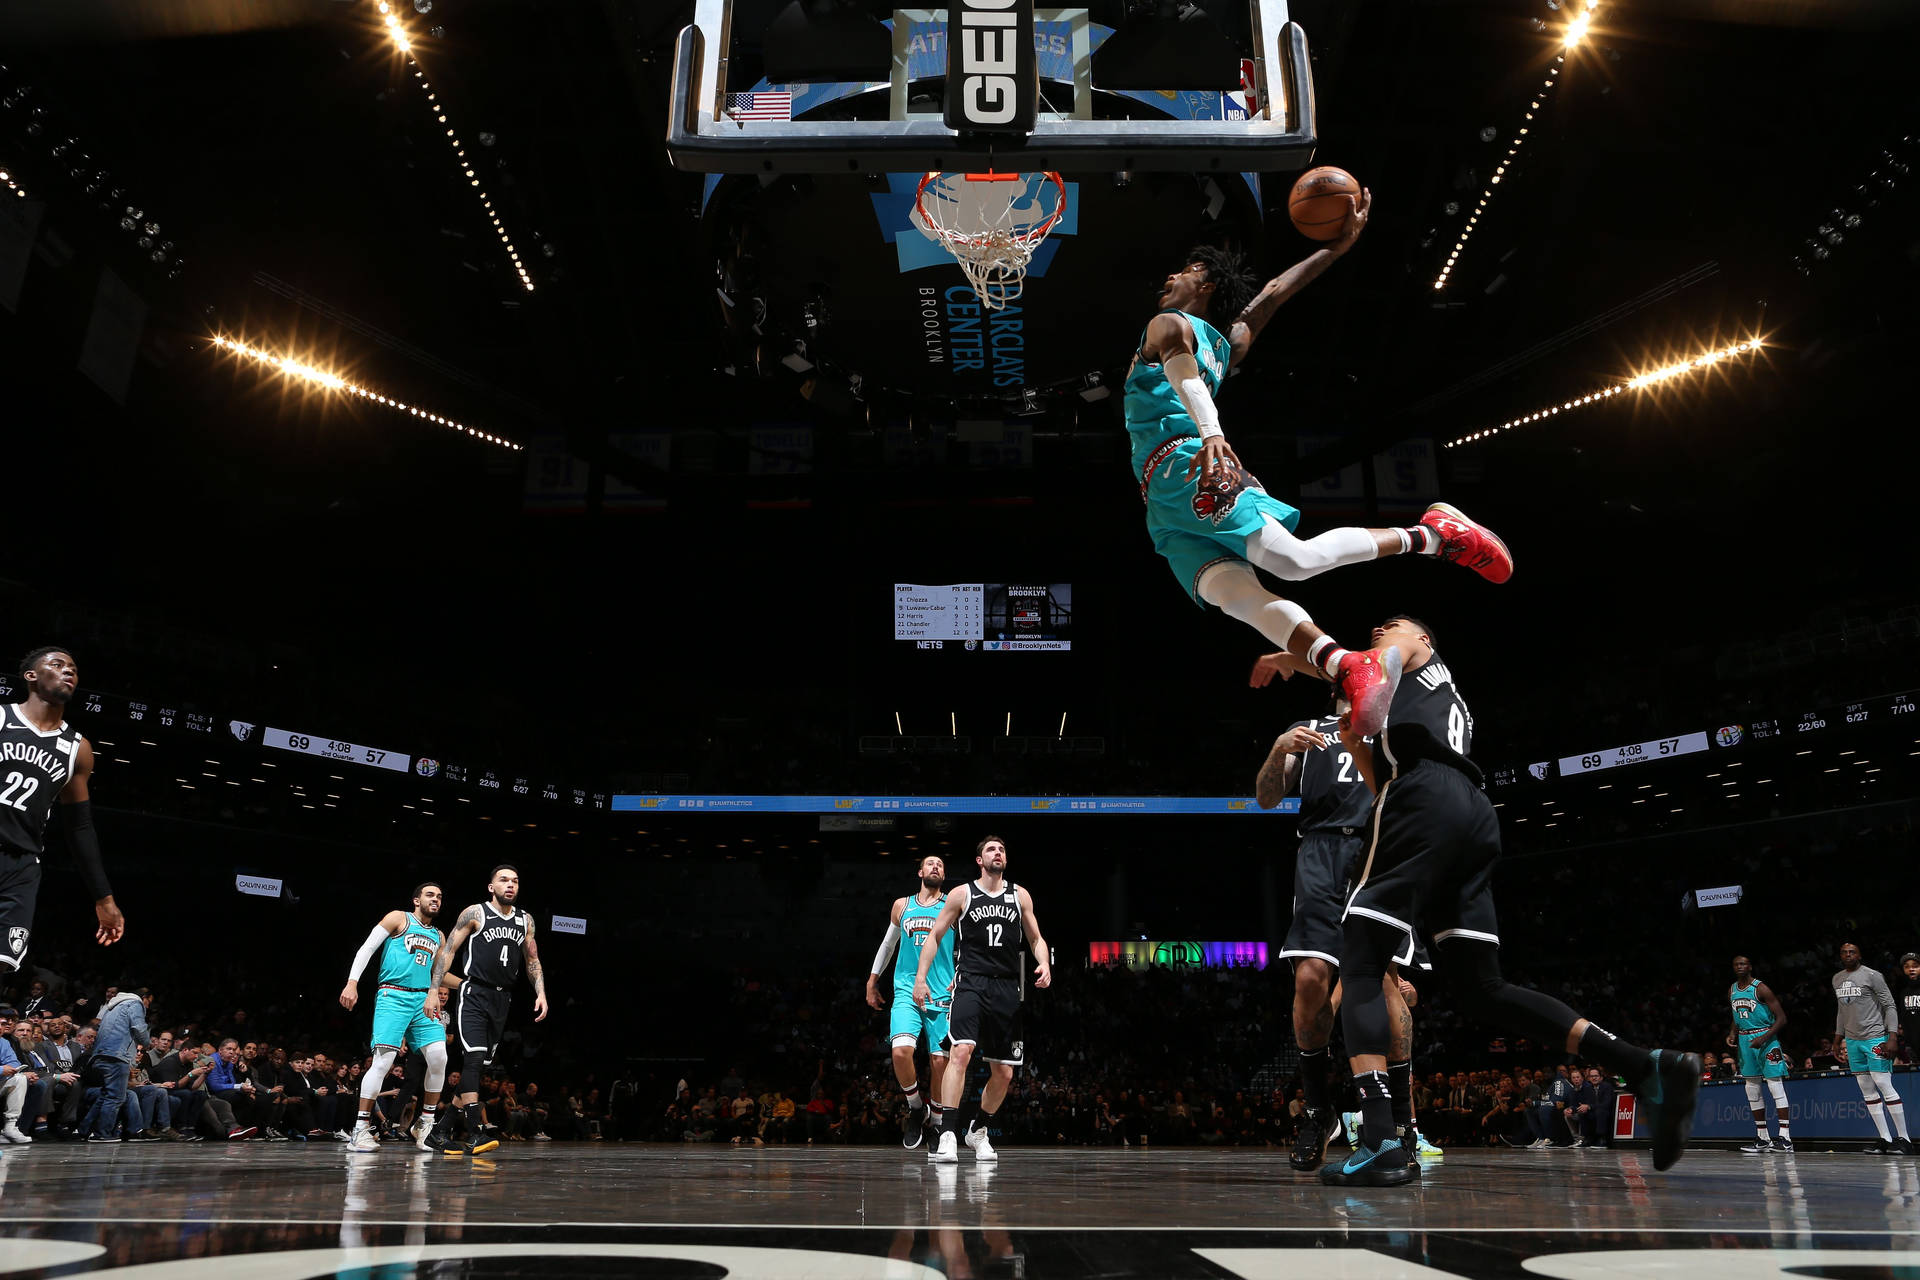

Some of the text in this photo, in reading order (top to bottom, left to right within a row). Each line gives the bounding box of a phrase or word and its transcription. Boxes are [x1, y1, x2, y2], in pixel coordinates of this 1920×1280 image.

[962, 0, 1018, 124] GEI
[1228, 110, 1245, 120] NBA
[919, 287, 944, 362] BROOKLYN
[944, 285, 984, 373] CENTER
[917, 641, 943, 649] NETS
[1012, 642, 1061, 650] @BrooklynNets
[85, 702, 102, 712] 7/8
[129, 702, 148, 711] REB
[159, 708, 176, 716] AST
[1891, 703, 1916, 715] 7/10
[130, 711, 143, 720] 38
[161, 717, 173, 726] 13
[1846, 712, 1868, 723] 6/27
[1798, 720, 1826, 732] 22/60
[288, 735, 310, 749] 69
[328, 741, 351, 753] 4:08
[1659, 739, 1679, 754] 57
[332, 752, 355, 761] Quarter
[366, 750, 386, 765] 57
[1618, 745, 1642, 758] 4:08
[0, 742, 66, 782] ROOKLYN
[1582, 755, 1602, 769] 69
[1626, 755, 1649, 764] Quarter
[480, 779, 500, 788] 22/60
[513, 785, 528, 794] 6/27
[0, 772, 39, 812] 22
[543, 791, 558, 799] 7/10
[574, 797, 583, 805] 32
[239, 880, 278, 892] CALVIN KLEIN
[969, 905, 1017, 923] BROOKLYN
[483, 928, 525, 946] BROOKLYN
[987, 924, 1002, 947] 12
[415, 952, 429, 966] 21
[500, 945, 508, 967] 4
[1739, 1010, 1749, 1019] 14
[1618, 1108, 1632, 1120] infor
[1717, 1103, 1750, 1122] LONG
[1804, 1098, 1868, 1121] UNIVERS
